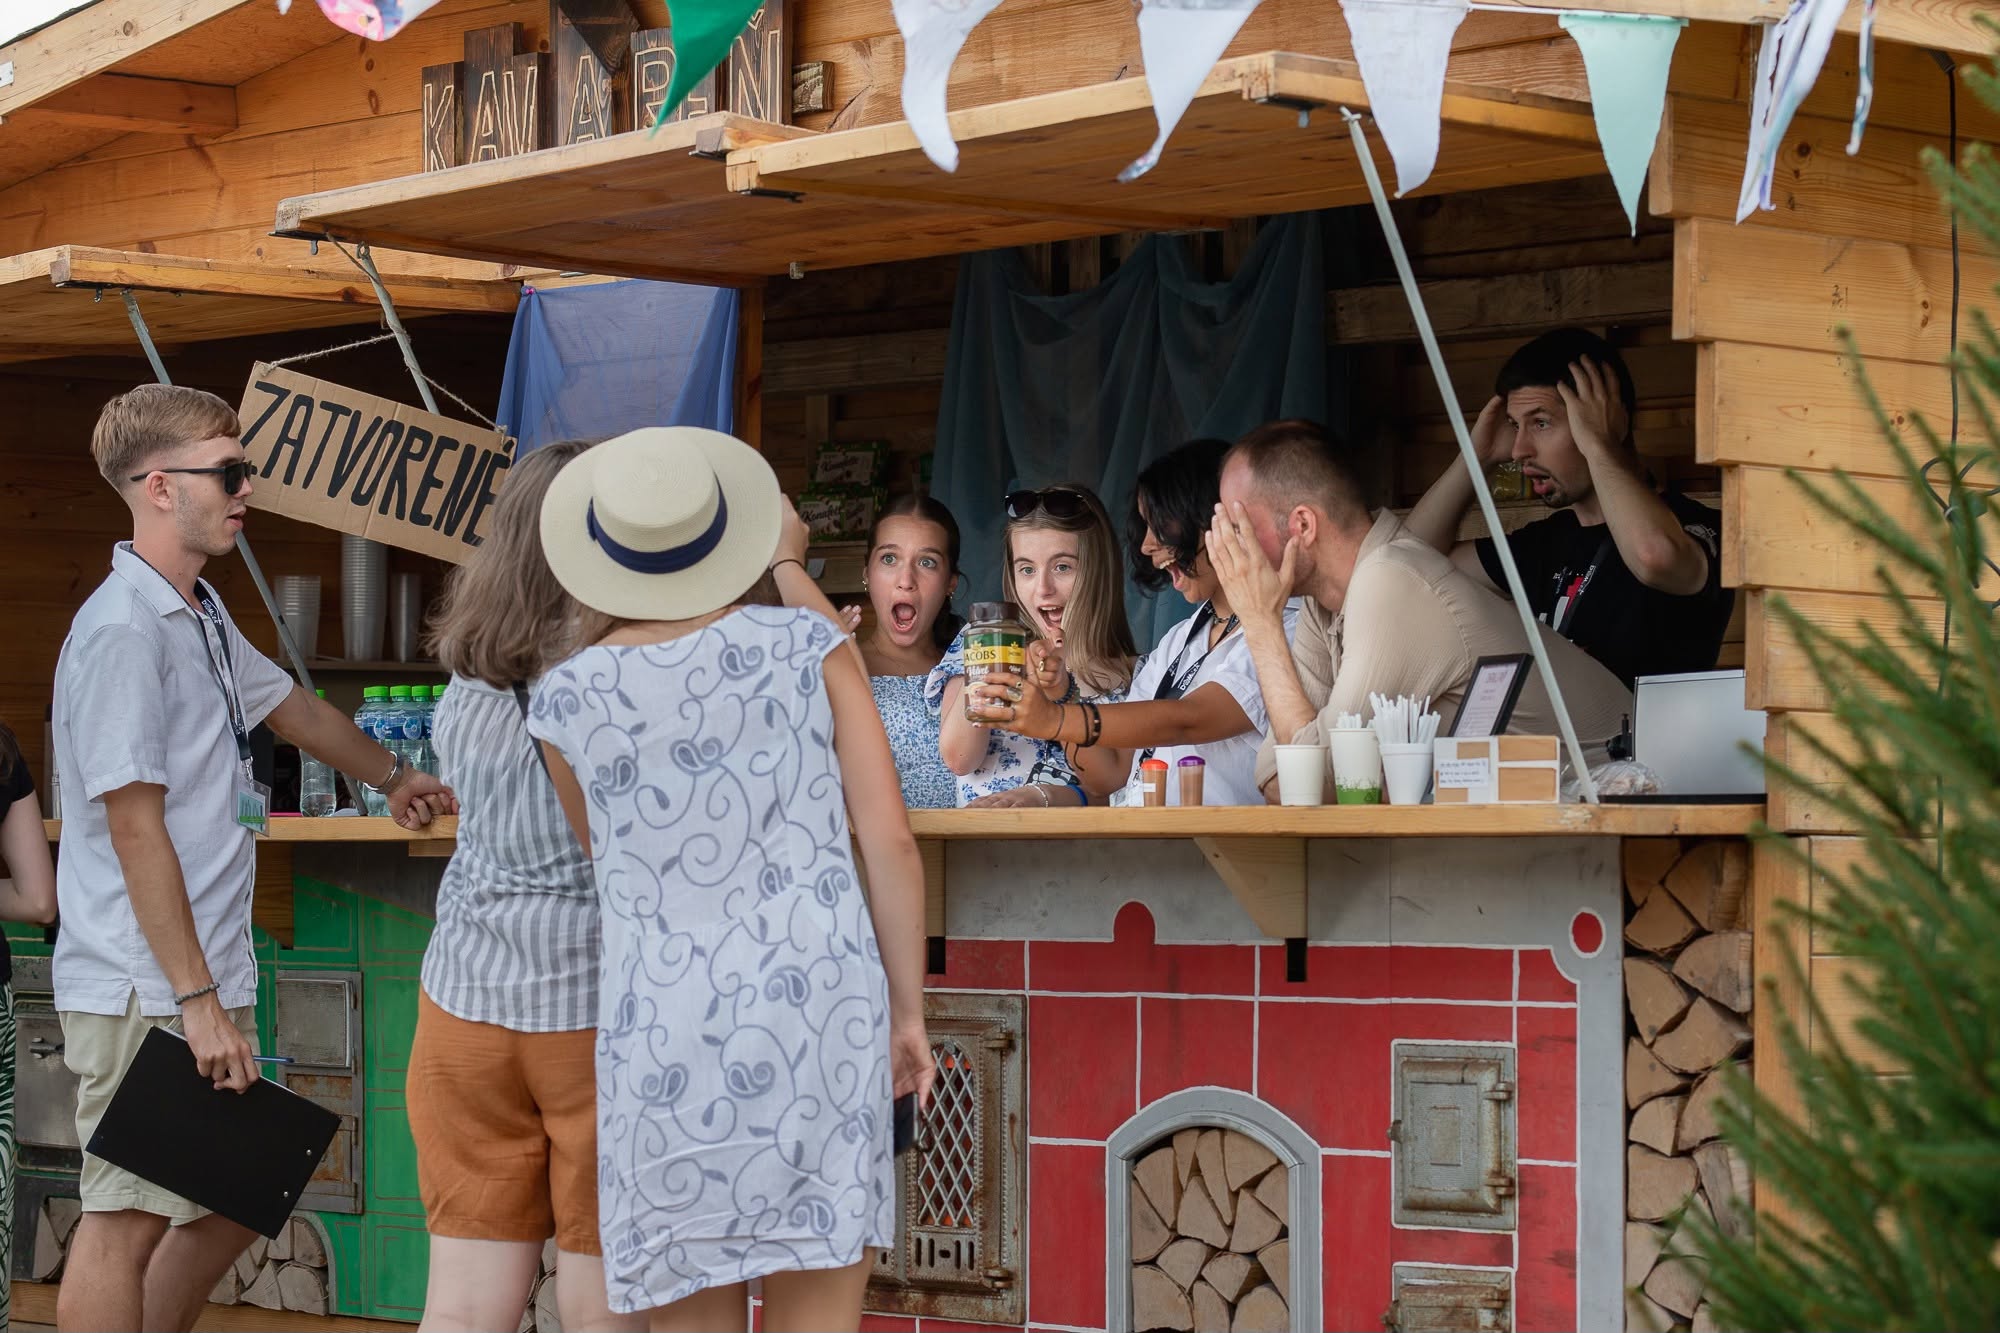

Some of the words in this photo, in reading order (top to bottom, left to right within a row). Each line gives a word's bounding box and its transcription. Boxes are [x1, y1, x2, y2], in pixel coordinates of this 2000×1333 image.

[423, 8, 780, 173] KAVARŇ
[240, 380, 516, 547] ZATVORENÉ
[964, 649, 997, 662] ACOBS
